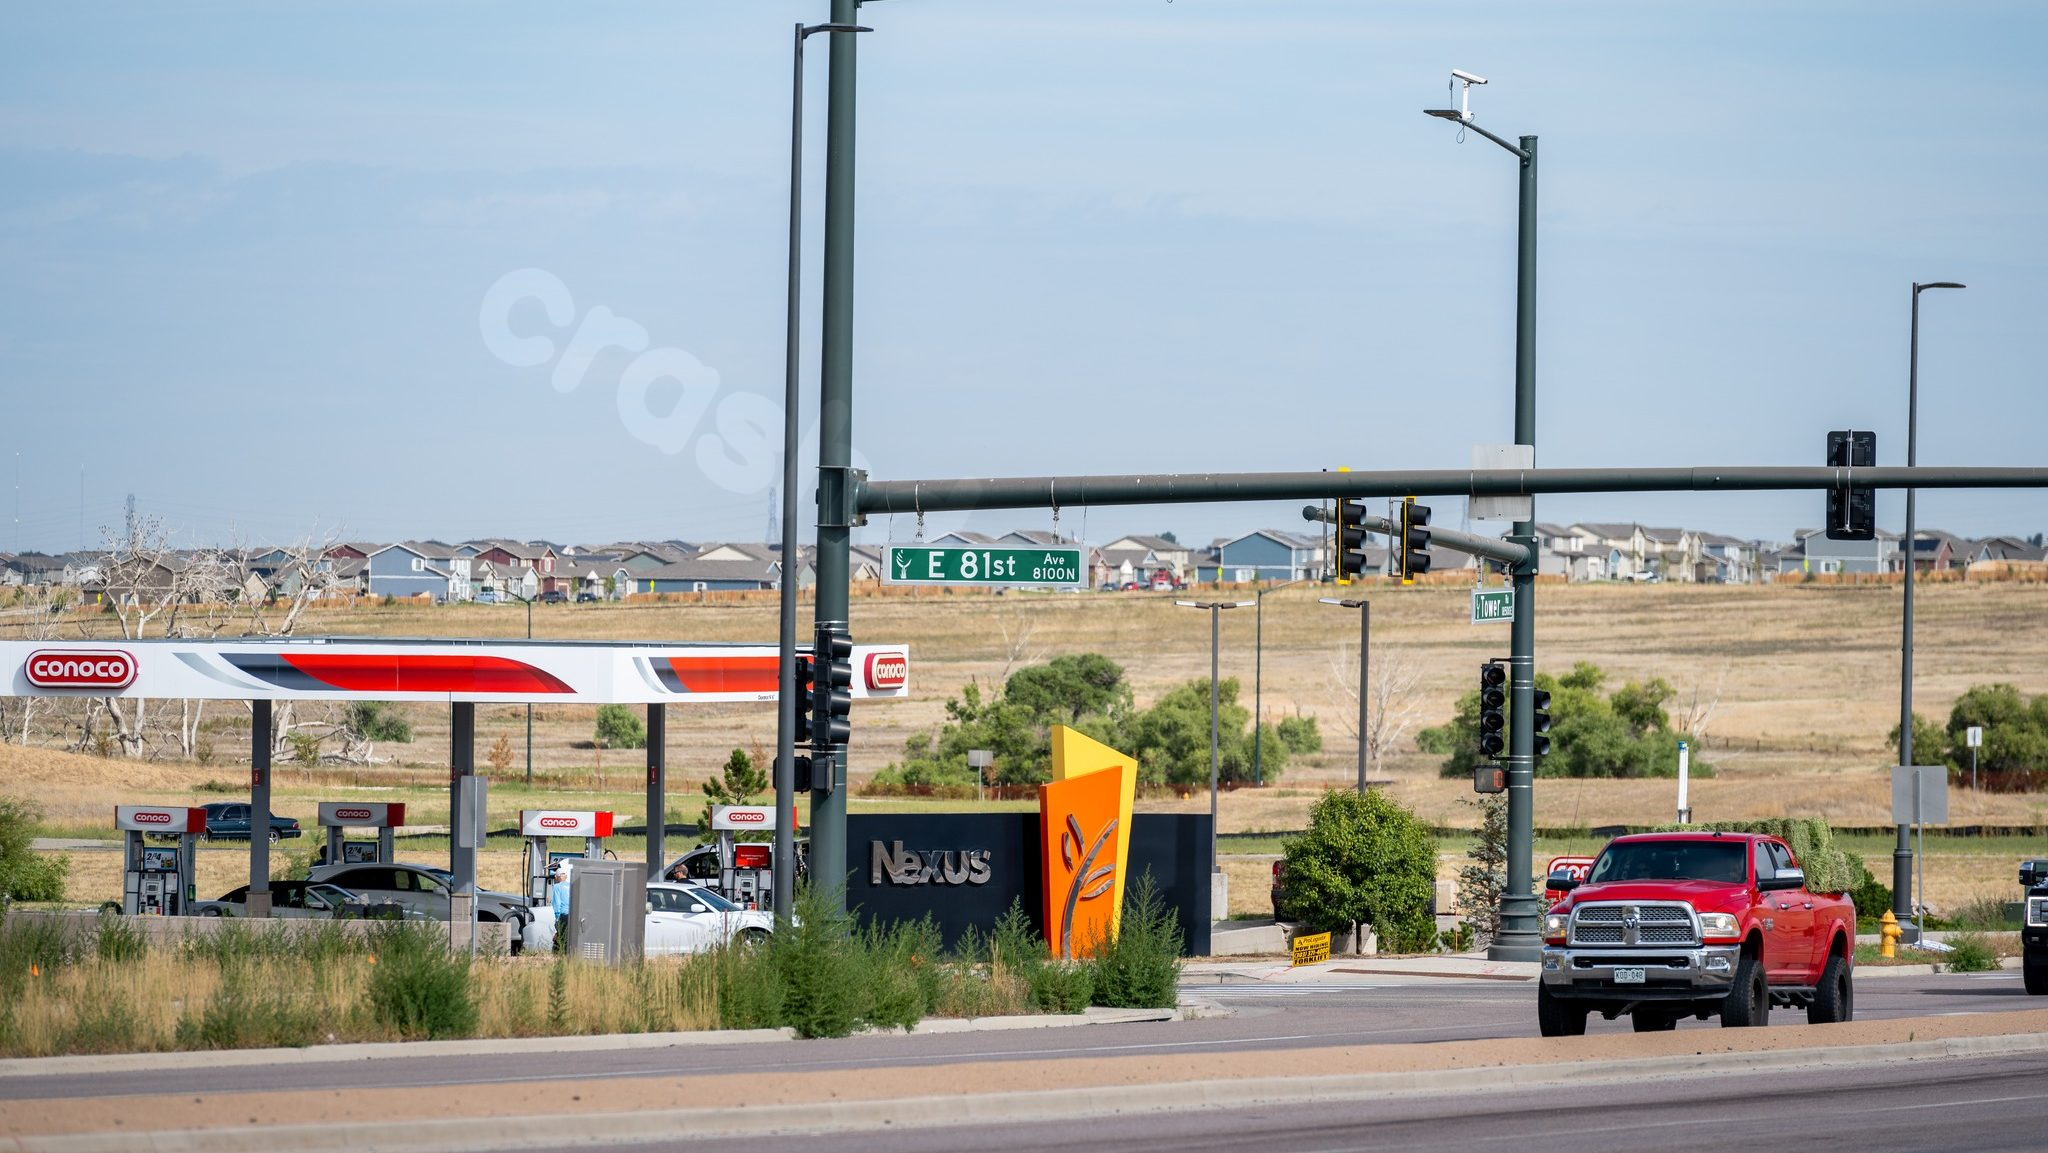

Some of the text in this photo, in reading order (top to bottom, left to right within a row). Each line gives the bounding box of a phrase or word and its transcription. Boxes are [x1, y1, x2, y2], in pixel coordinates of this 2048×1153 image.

[929, 551, 1016, 579] E 81st
[1043, 553, 1065, 565] Ave
[1032, 567, 1075, 580] 8100N
[1480, 595, 1501, 618] Tower
[871, 840, 992, 885] Nexus
[1294, 954, 1327, 965] FORKLIFT
